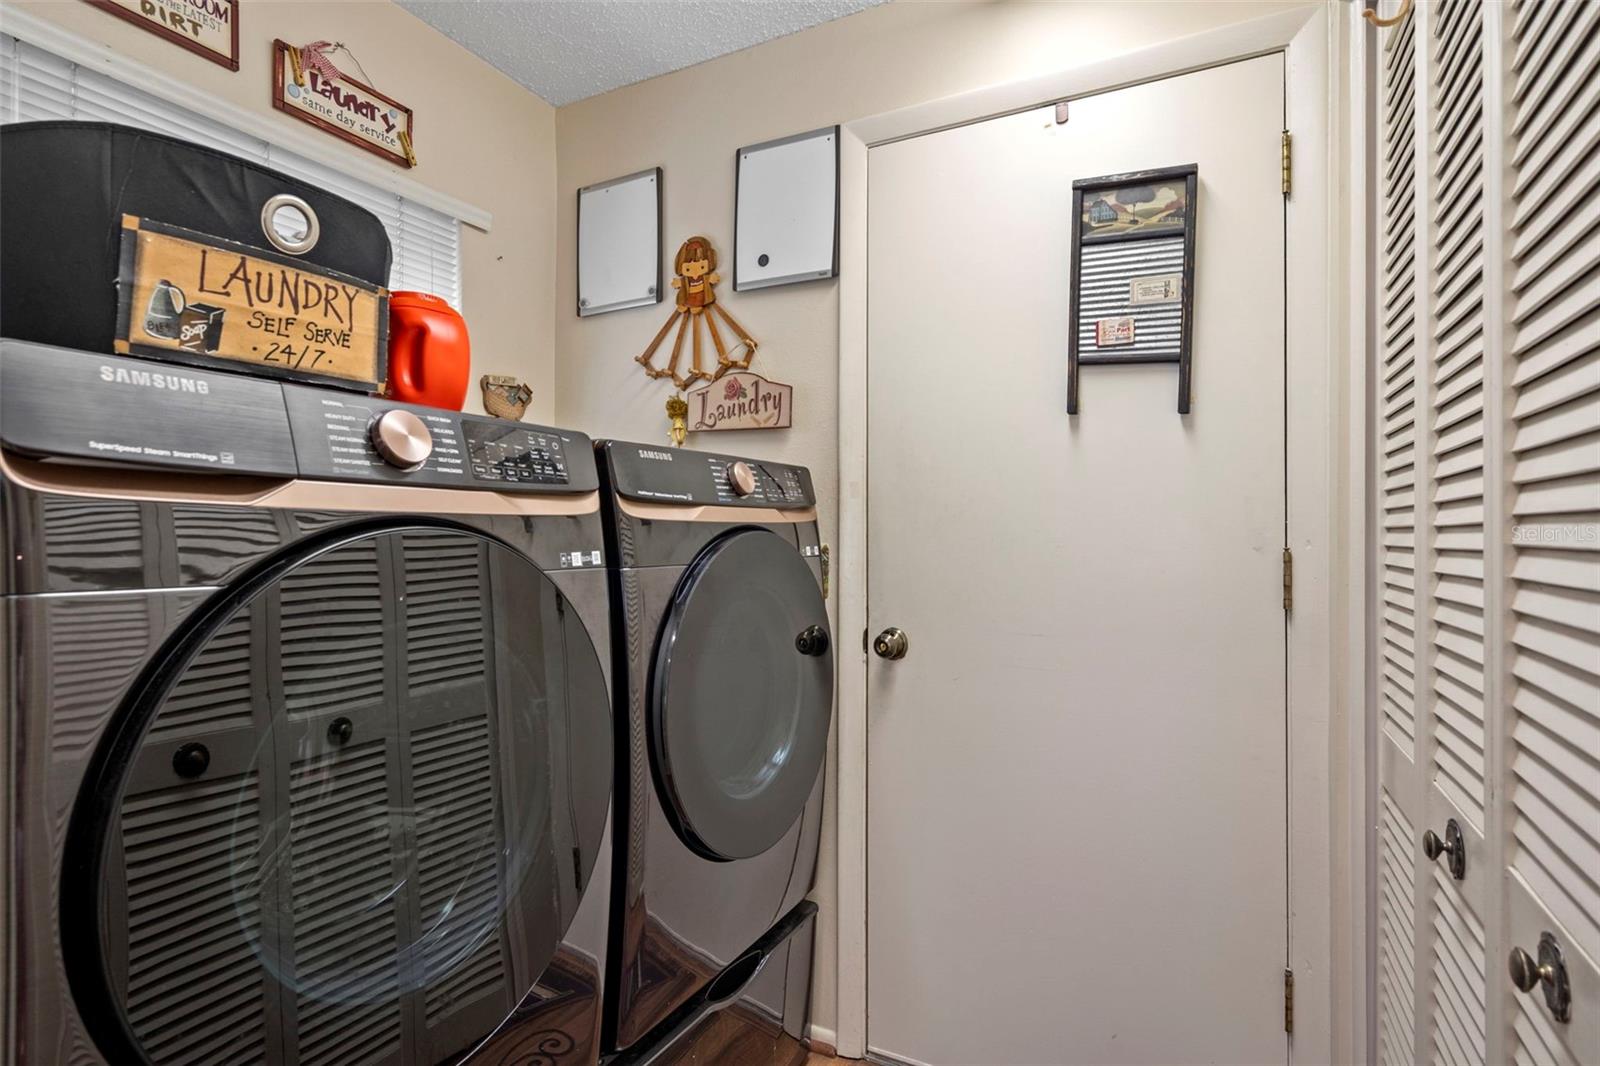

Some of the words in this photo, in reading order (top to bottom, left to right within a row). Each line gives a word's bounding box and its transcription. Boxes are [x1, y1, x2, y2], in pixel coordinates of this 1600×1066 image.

[140, 0, 203, 37] DIRT
[183, 4, 223, 32] LATEST
[302, 96, 333, 118] same
[336, 110, 356, 128] day
[360, 123, 396, 146] service
[198, 249, 359, 333] LAUNDRY
[247, 310, 297, 338] SELF
[303, 321, 351, 349] SERVE
[100, 365, 209, 394] SAMSUNG
[695, 379, 782, 430] Laundry
[638, 450, 672, 461] SAMSUNG
